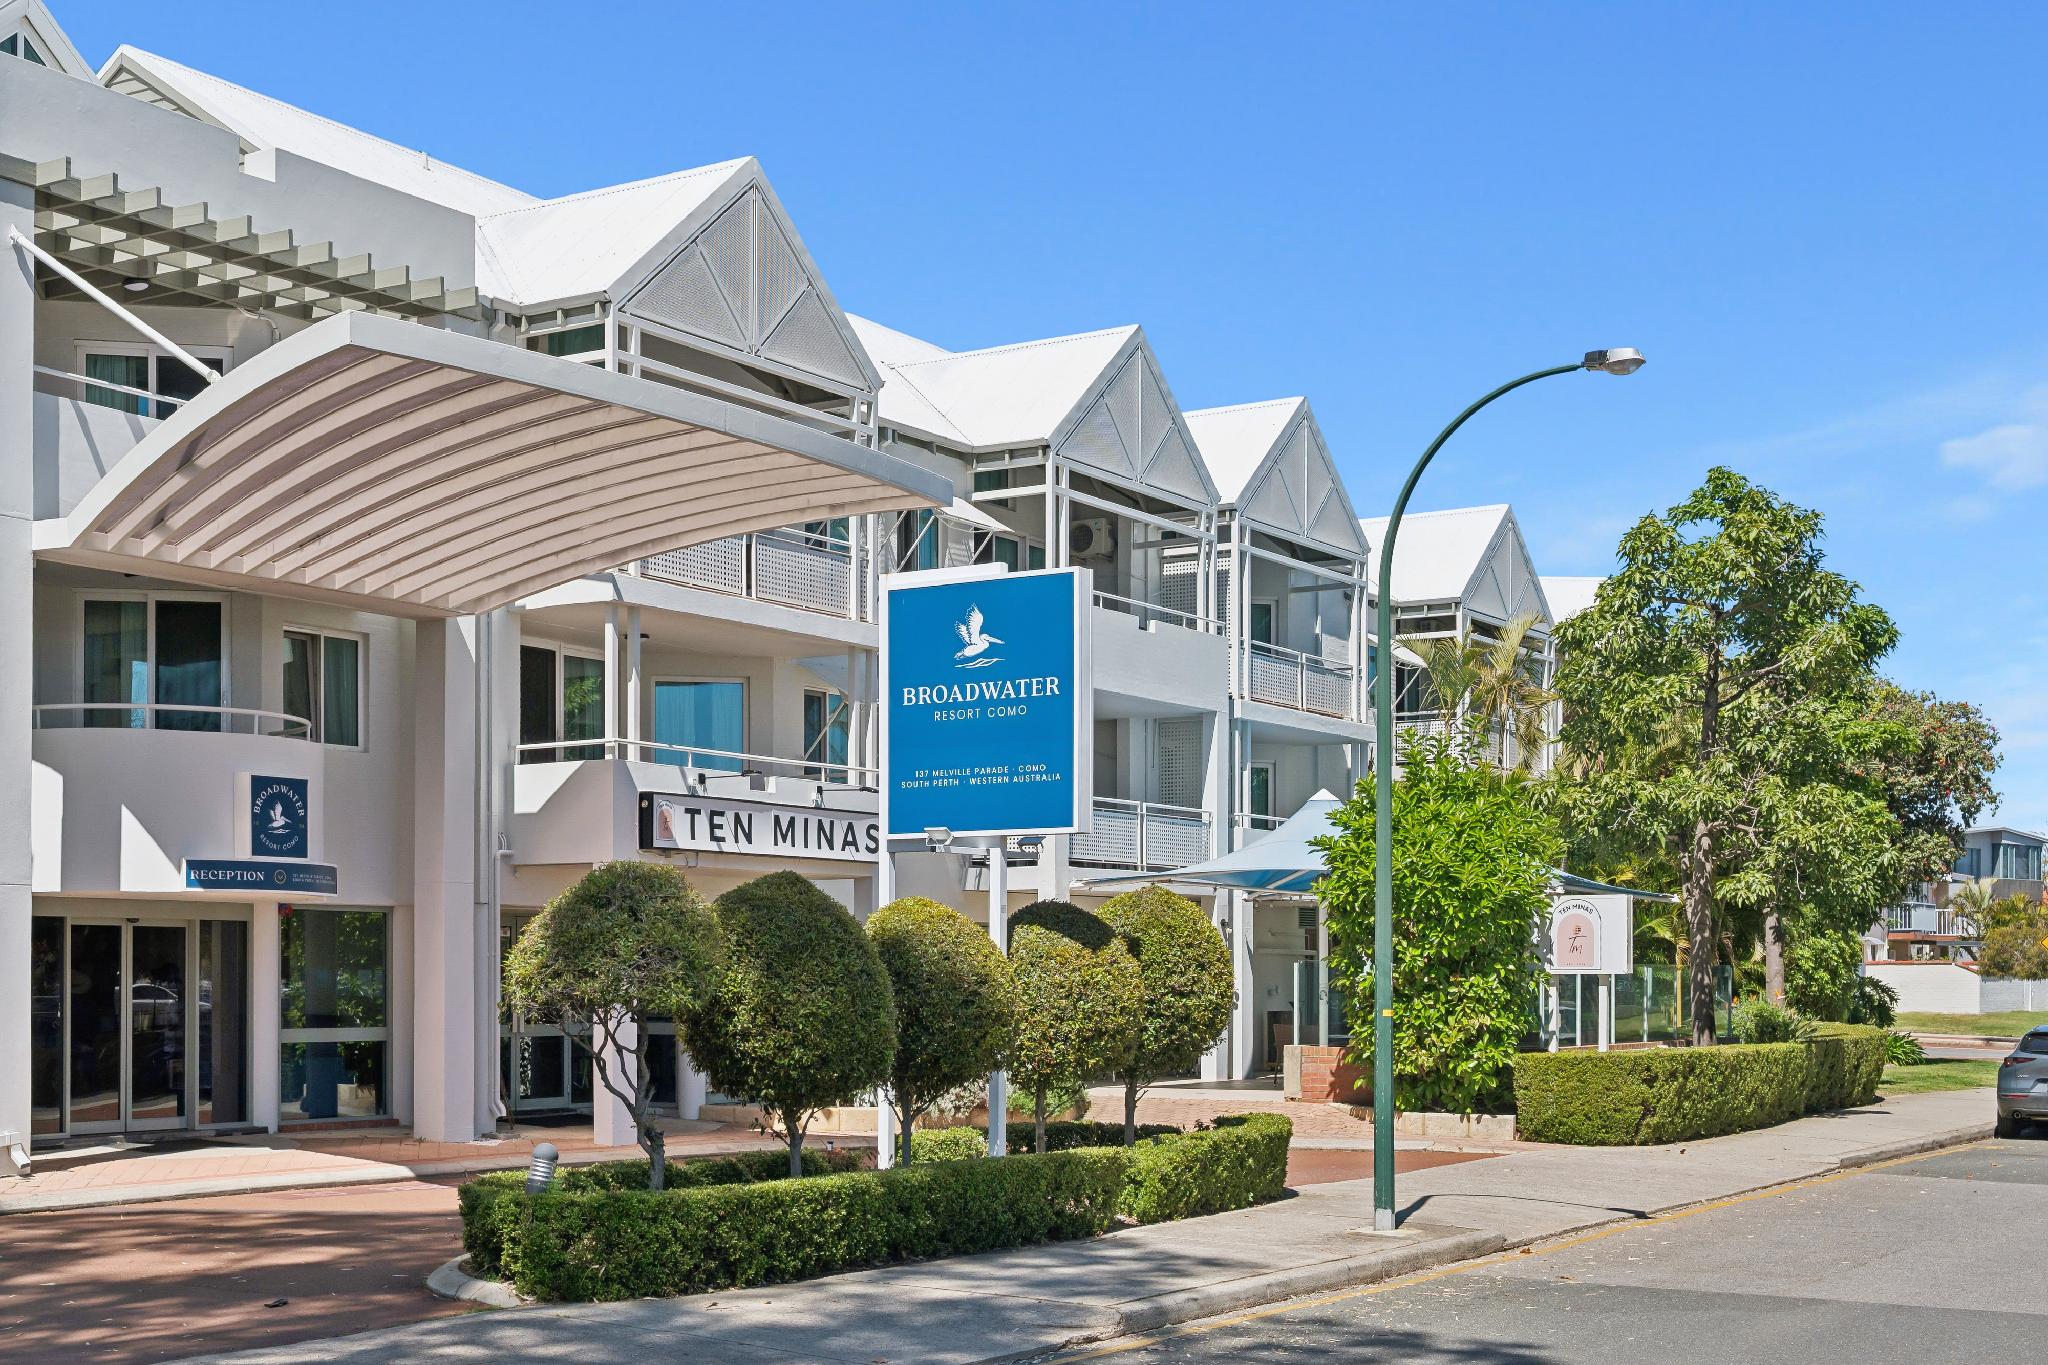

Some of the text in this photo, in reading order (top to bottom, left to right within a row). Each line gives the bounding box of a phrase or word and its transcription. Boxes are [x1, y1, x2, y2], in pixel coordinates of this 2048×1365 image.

[902, 676, 1060, 706] BROADWATER
[934, 704, 1027, 722] RESORT COMO
[932, 767, 971, 777] MELVILLE
[974, 765, 1009, 775] PARADE
[1018, 763, 1047, 773] COMO
[901, 772, 1061, 788] SOUTH PERTH WESTERN AUSTRALIA
[253, 784, 305, 817] BROADWATER
[684, 807, 879, 854] TEN MINAS
[190, 869, 265, 881] RECEPTION
[1559, 903, 1594, 916] TEN MINAS
